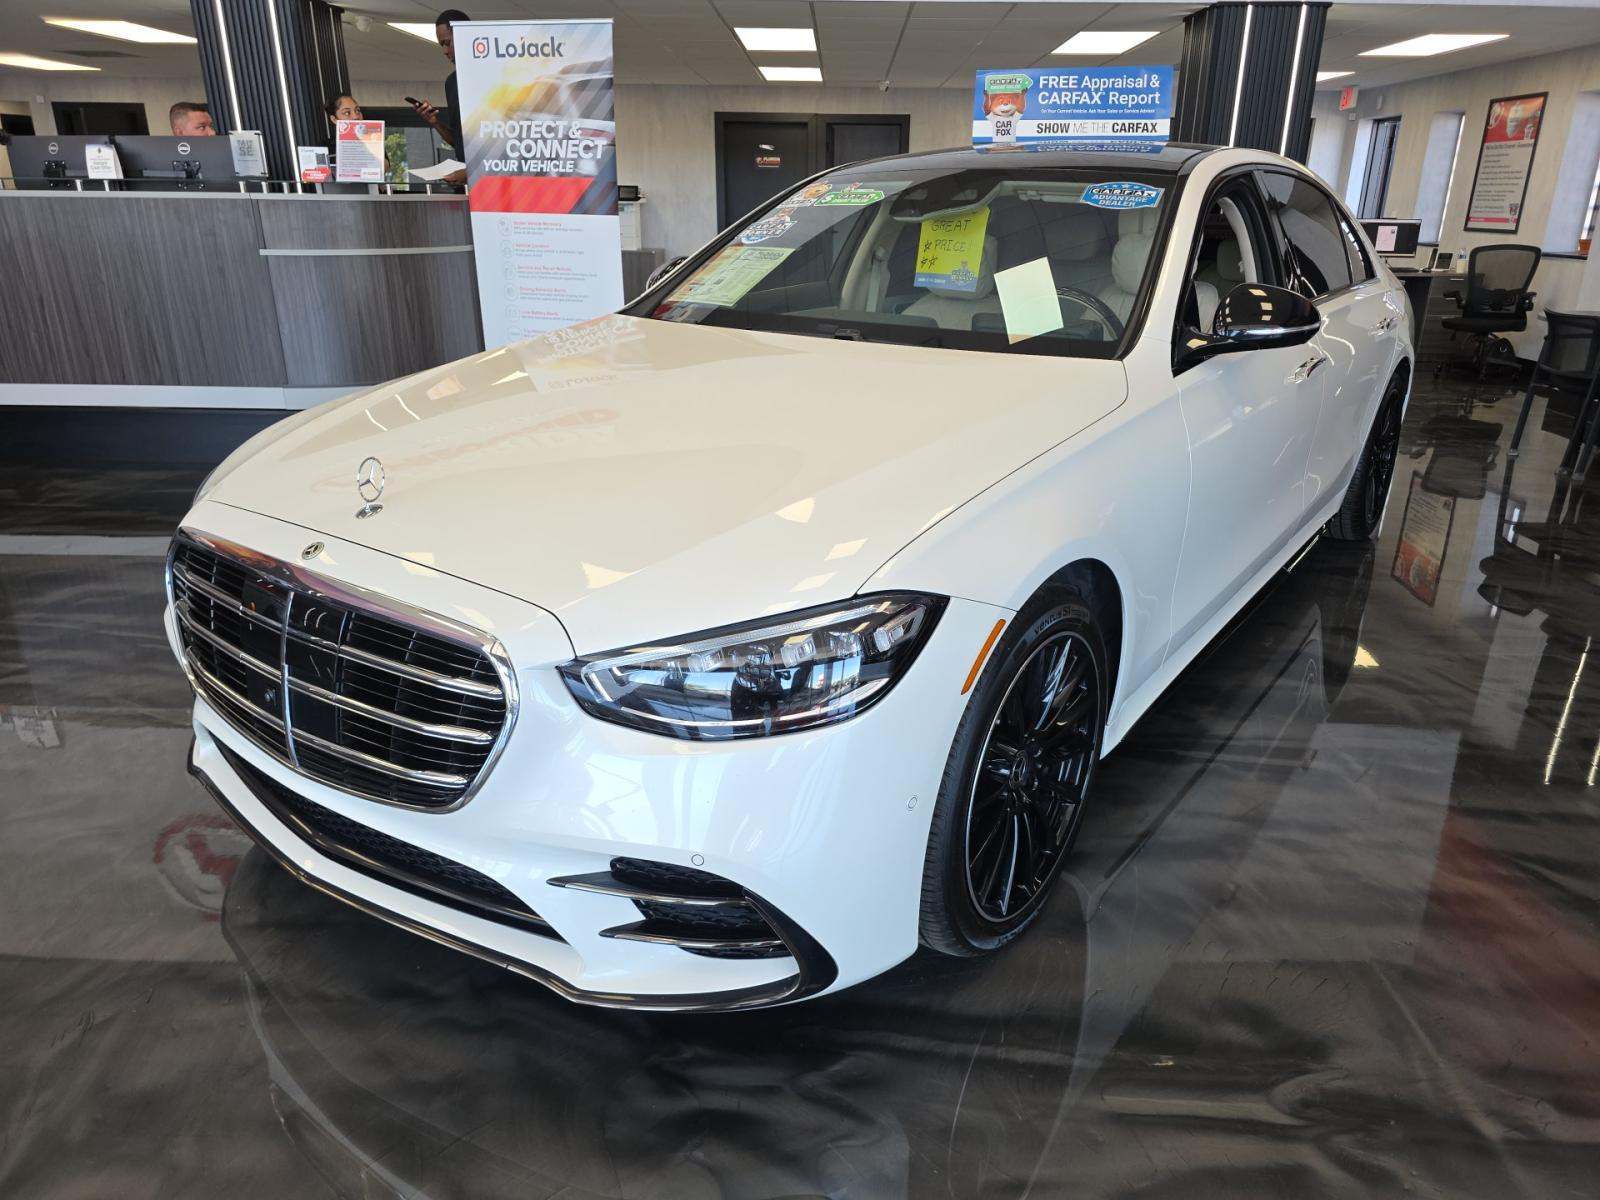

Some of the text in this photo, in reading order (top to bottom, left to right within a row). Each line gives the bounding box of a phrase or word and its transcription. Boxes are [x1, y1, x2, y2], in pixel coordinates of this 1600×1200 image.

[1039, 74, 1160, 91] FREE Appraisal &
[1038, 91, 1160, 107] CARFAX Report
[479, 120, 582, 139] PROTECT &
[995, 120, 1012, 128] CAR
[1036, 122, 1158, 134] SHOW ME THE CARFAX
[995, 128, 1011, 136] FOX
[506, 139, 608, 159] CONNECT
[483, 159, 574, 173] YOUR VEHICLE
[1090, 188, 1156, 197] CARFAX
[1091, 195, 1148, 203] ADVANTAGE
[931, 218, 972, 233] GREAT
